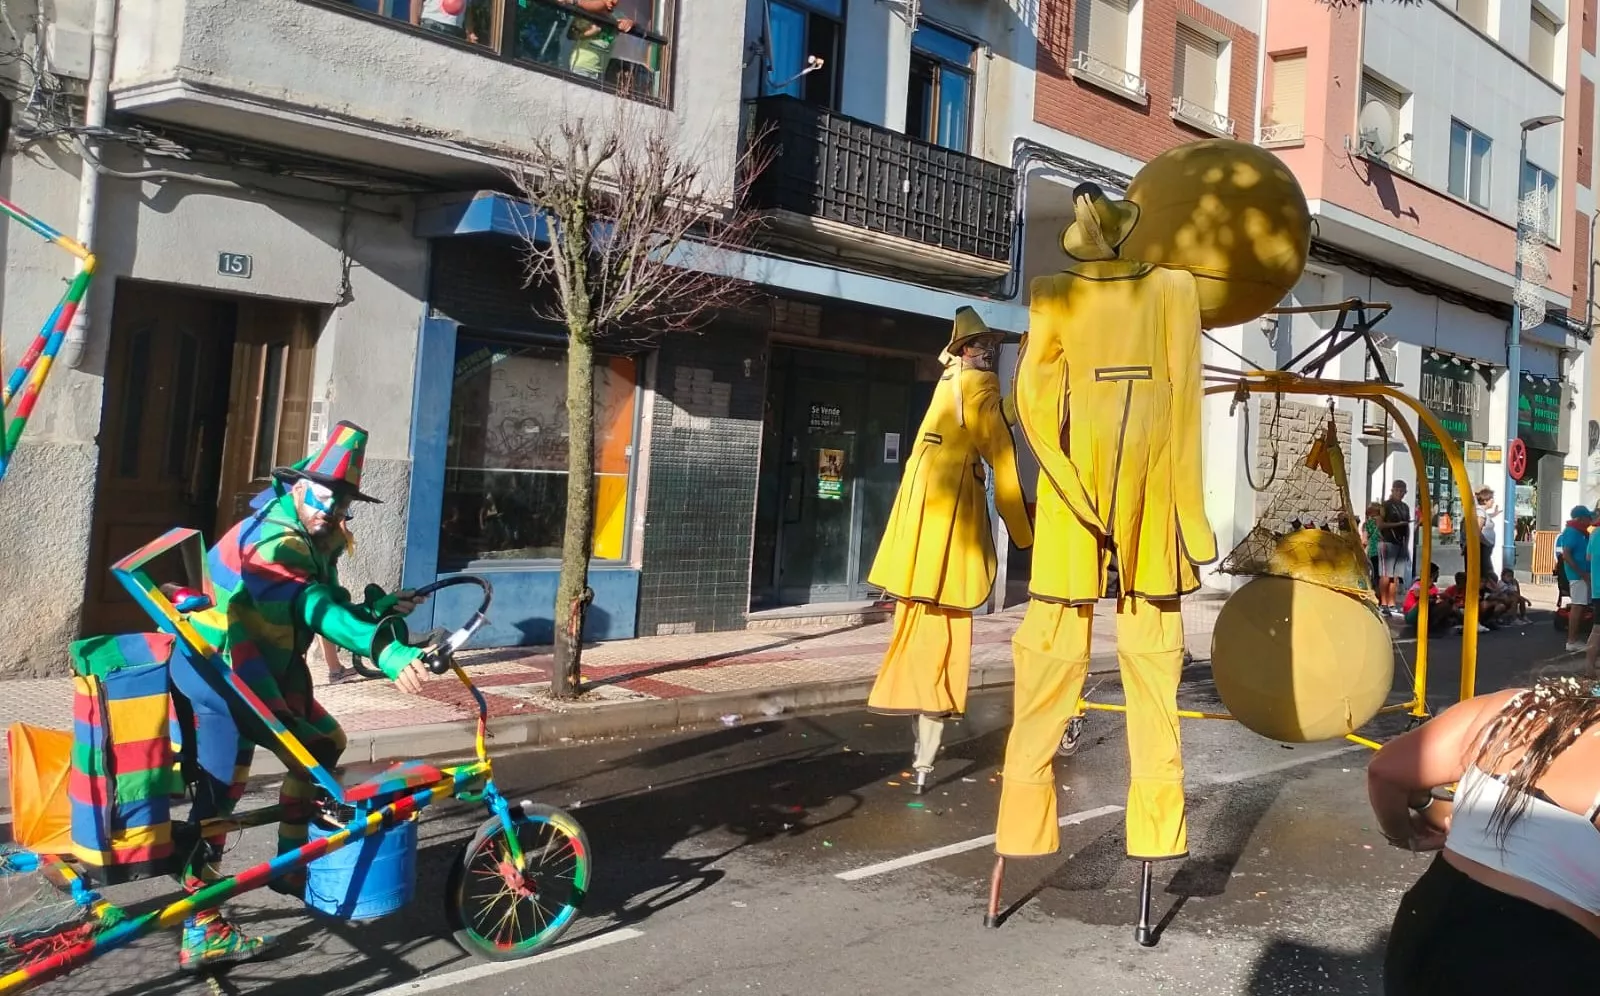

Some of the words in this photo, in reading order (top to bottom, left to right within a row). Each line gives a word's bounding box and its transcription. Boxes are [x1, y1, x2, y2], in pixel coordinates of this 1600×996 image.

[224, 254, 243, 272] 15
[811, 405, 820, 414] Se
[821, 406, 841, 416] Vende
